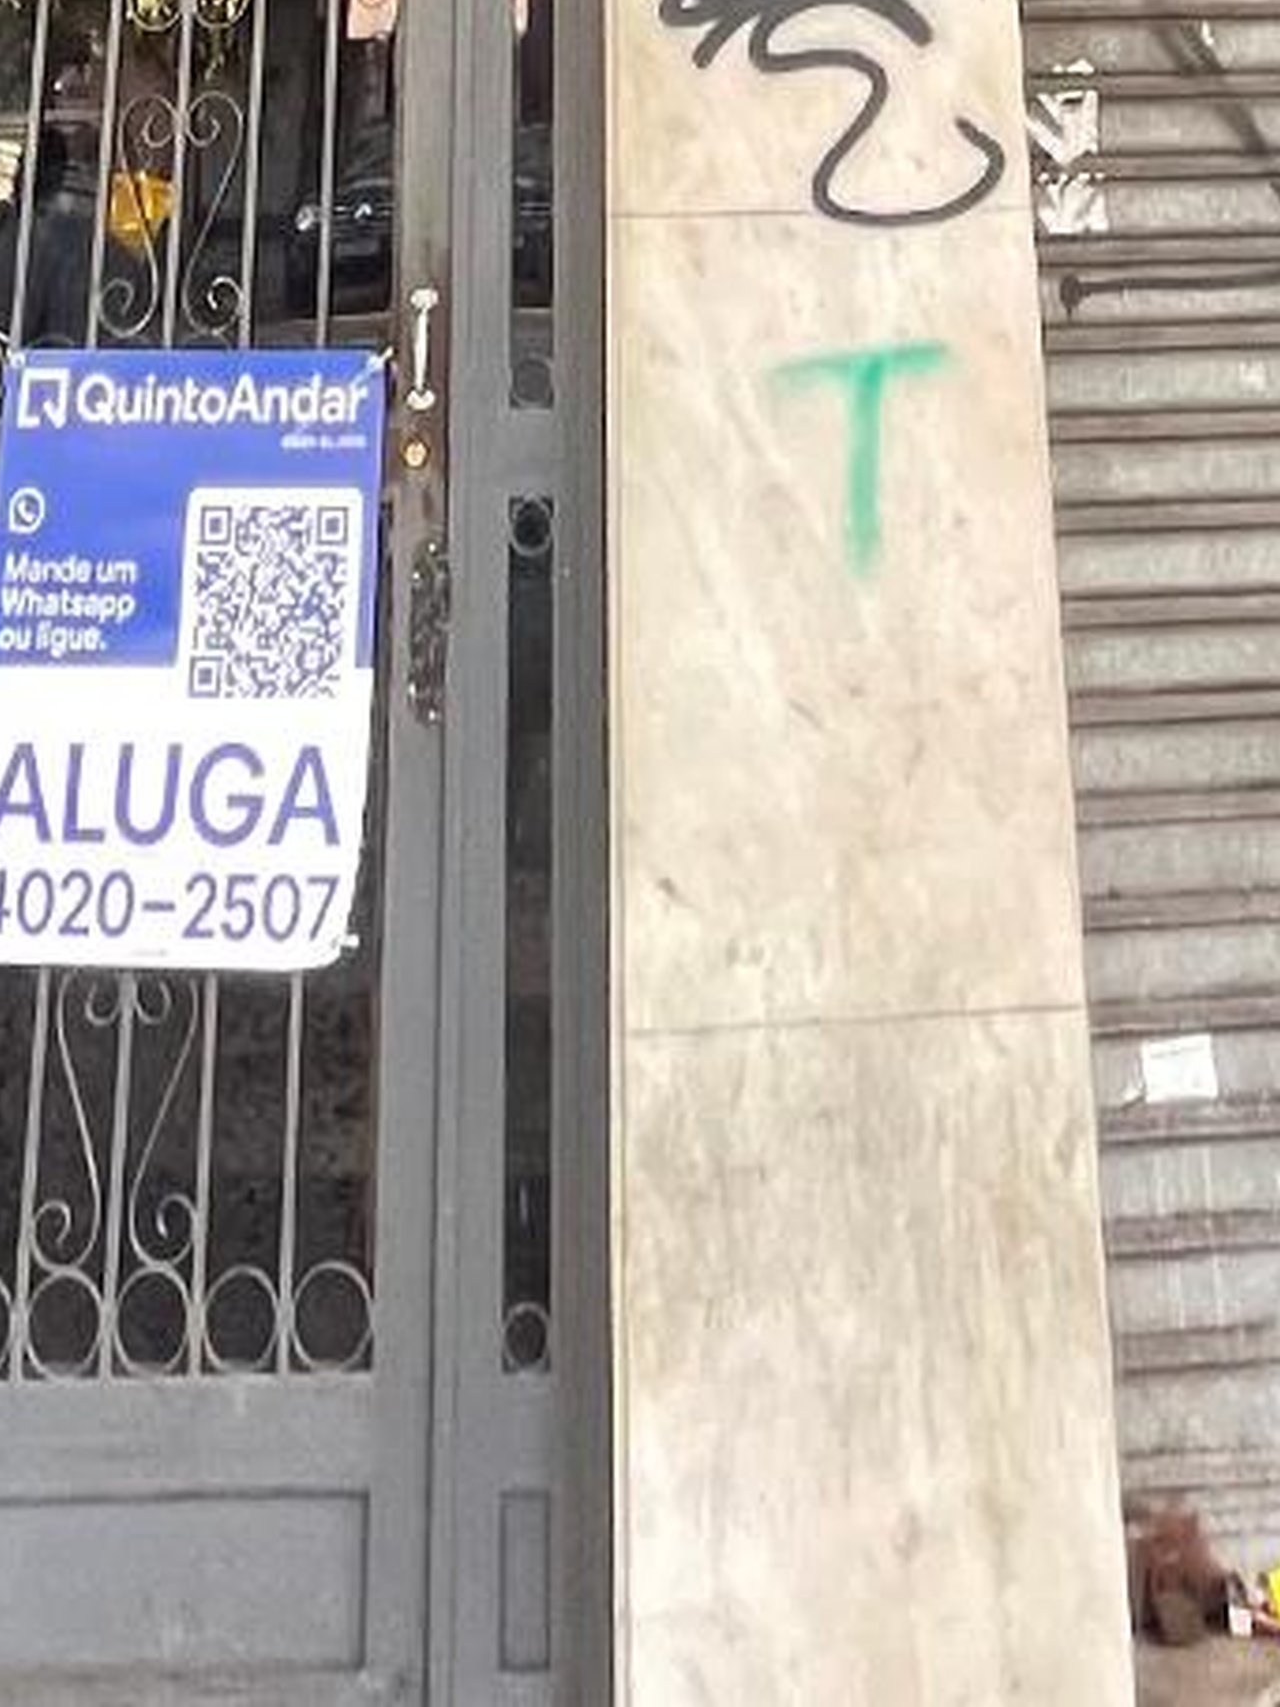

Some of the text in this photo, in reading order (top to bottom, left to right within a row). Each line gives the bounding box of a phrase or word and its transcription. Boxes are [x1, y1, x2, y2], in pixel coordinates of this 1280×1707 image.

[76, 372, 368, 424] QuintoAndar
[6, 552, 139, 584] Mande um
[1, 584, 136, 624] Whatsapp
[35, 620, 107, 658] ligue.
